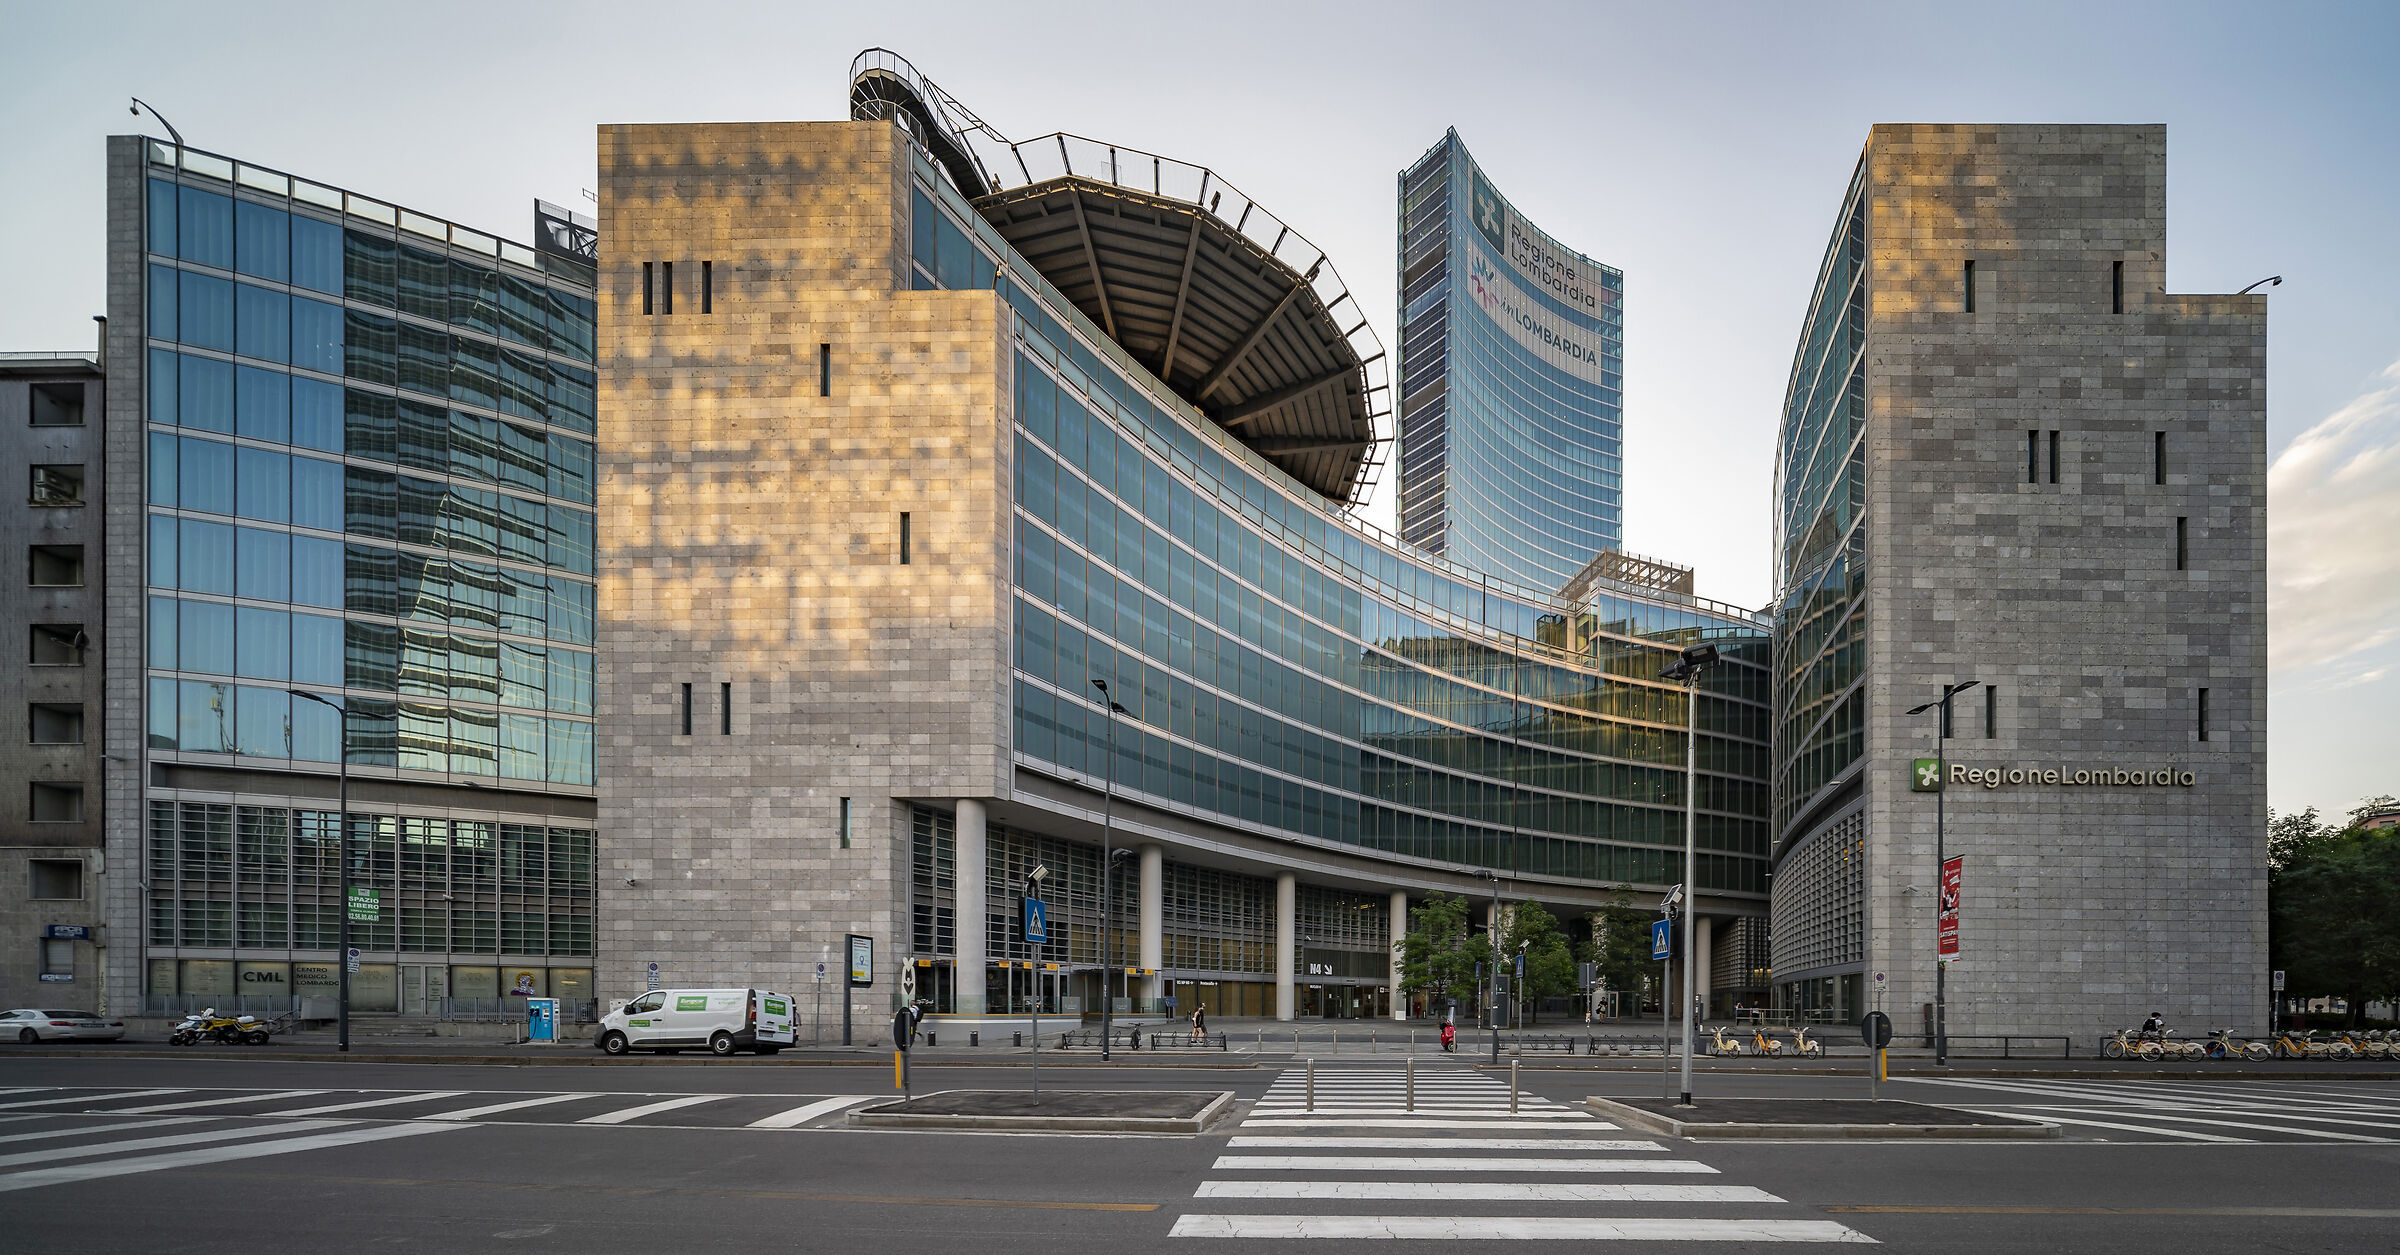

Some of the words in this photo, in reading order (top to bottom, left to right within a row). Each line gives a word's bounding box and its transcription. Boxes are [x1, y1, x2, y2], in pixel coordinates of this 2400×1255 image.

[1511, 223, 1576, 281] Regione
[1511, 242, 1595, 308] Lombardia
[348, 896, 379, 904] SPAZIO
[348, 902, 379, 910] LIBERO
[1310, 963, 1321, 975] N4
[243, 971, 284, 982] CML
